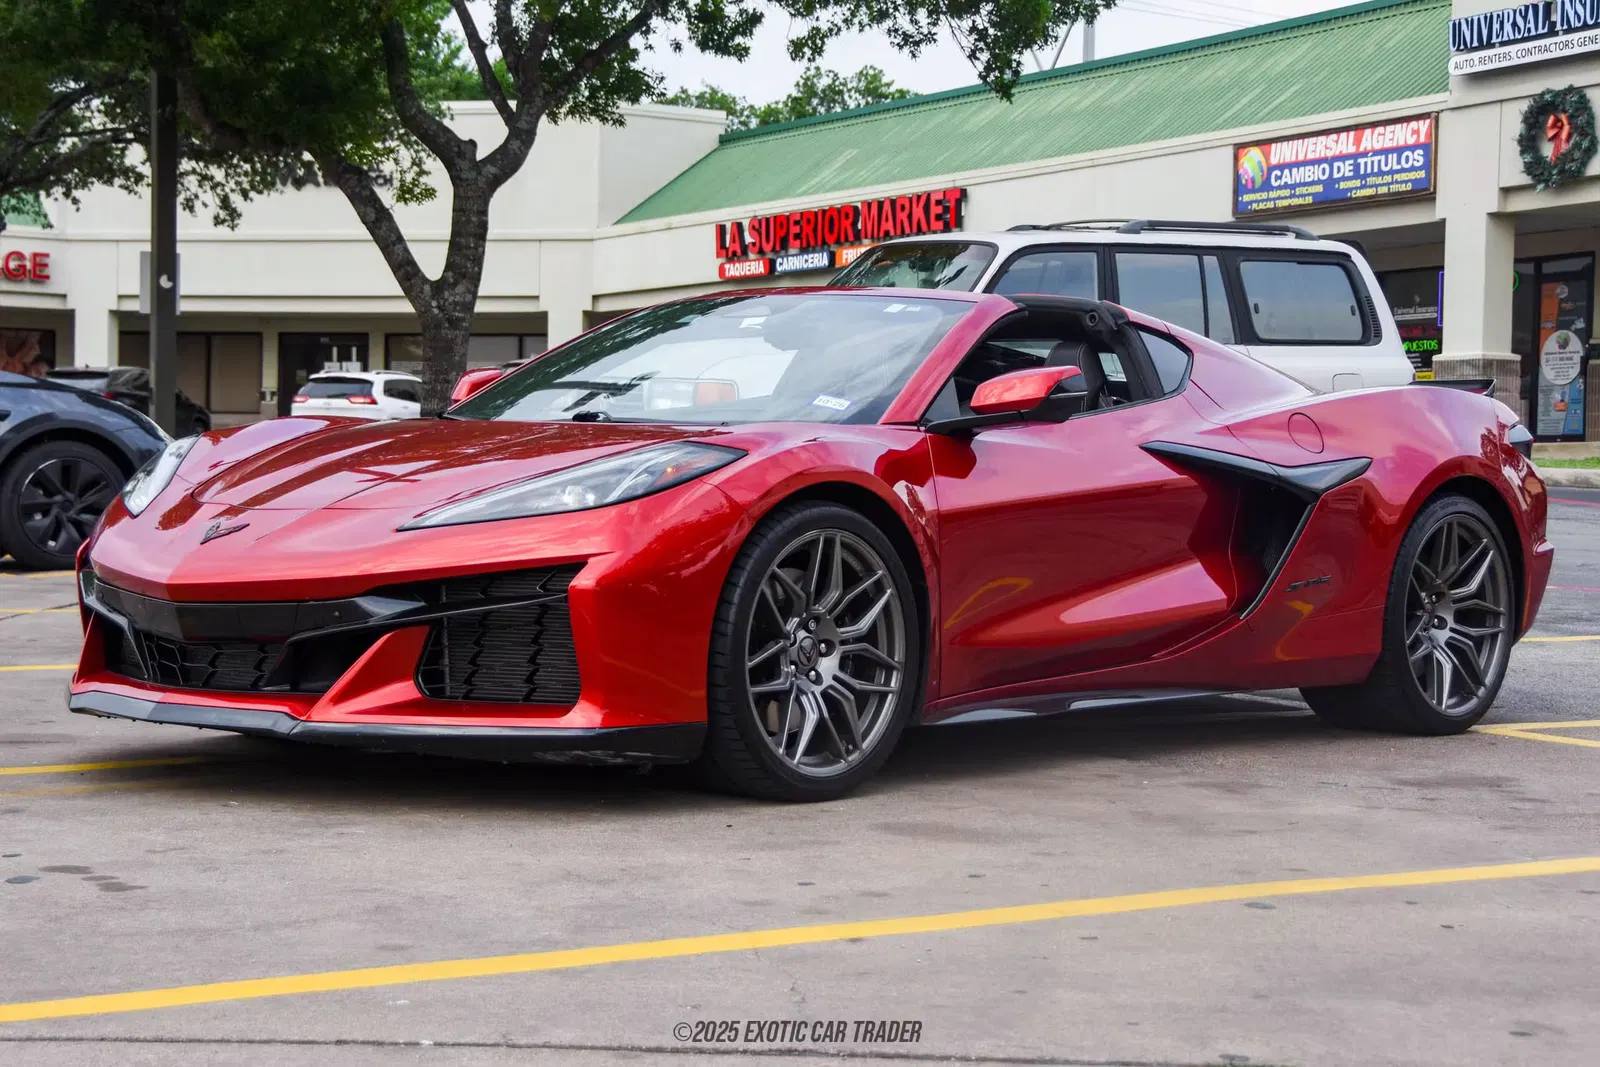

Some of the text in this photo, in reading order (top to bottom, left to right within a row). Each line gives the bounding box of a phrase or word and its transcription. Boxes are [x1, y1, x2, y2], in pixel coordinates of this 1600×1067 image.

[1449, 0, 1600, 51] UNIVERSAL INSU
[1515, 38, 1575, 60] CONTRACTORS
[1576, 33, 1600, 48] GENE
[1270, 118, 1431, 165] UNIVERSAL AGENCY
[1270, 149, 1425, 187] CAMBIO DE TÍTULOS
[1366, 174, 1393, 186] TÍTULOS
[1393, 170, 1426, 182] PERDIDOS
[1242, 192, 1268, 202] SERVICIO
[1351, 182, 1412, 198] CAMBIO SIN TÍTULO
[1251, 196, 1313, 211] PLACAS TEMPORALES
[715, 187, 964, 259] LA SUPERIOR MARKET
[0, 250, 51, 280] GE
[724, 262, 765, 280] TAQUERIA
[776, 251, 829, 273] CARNICERIA
